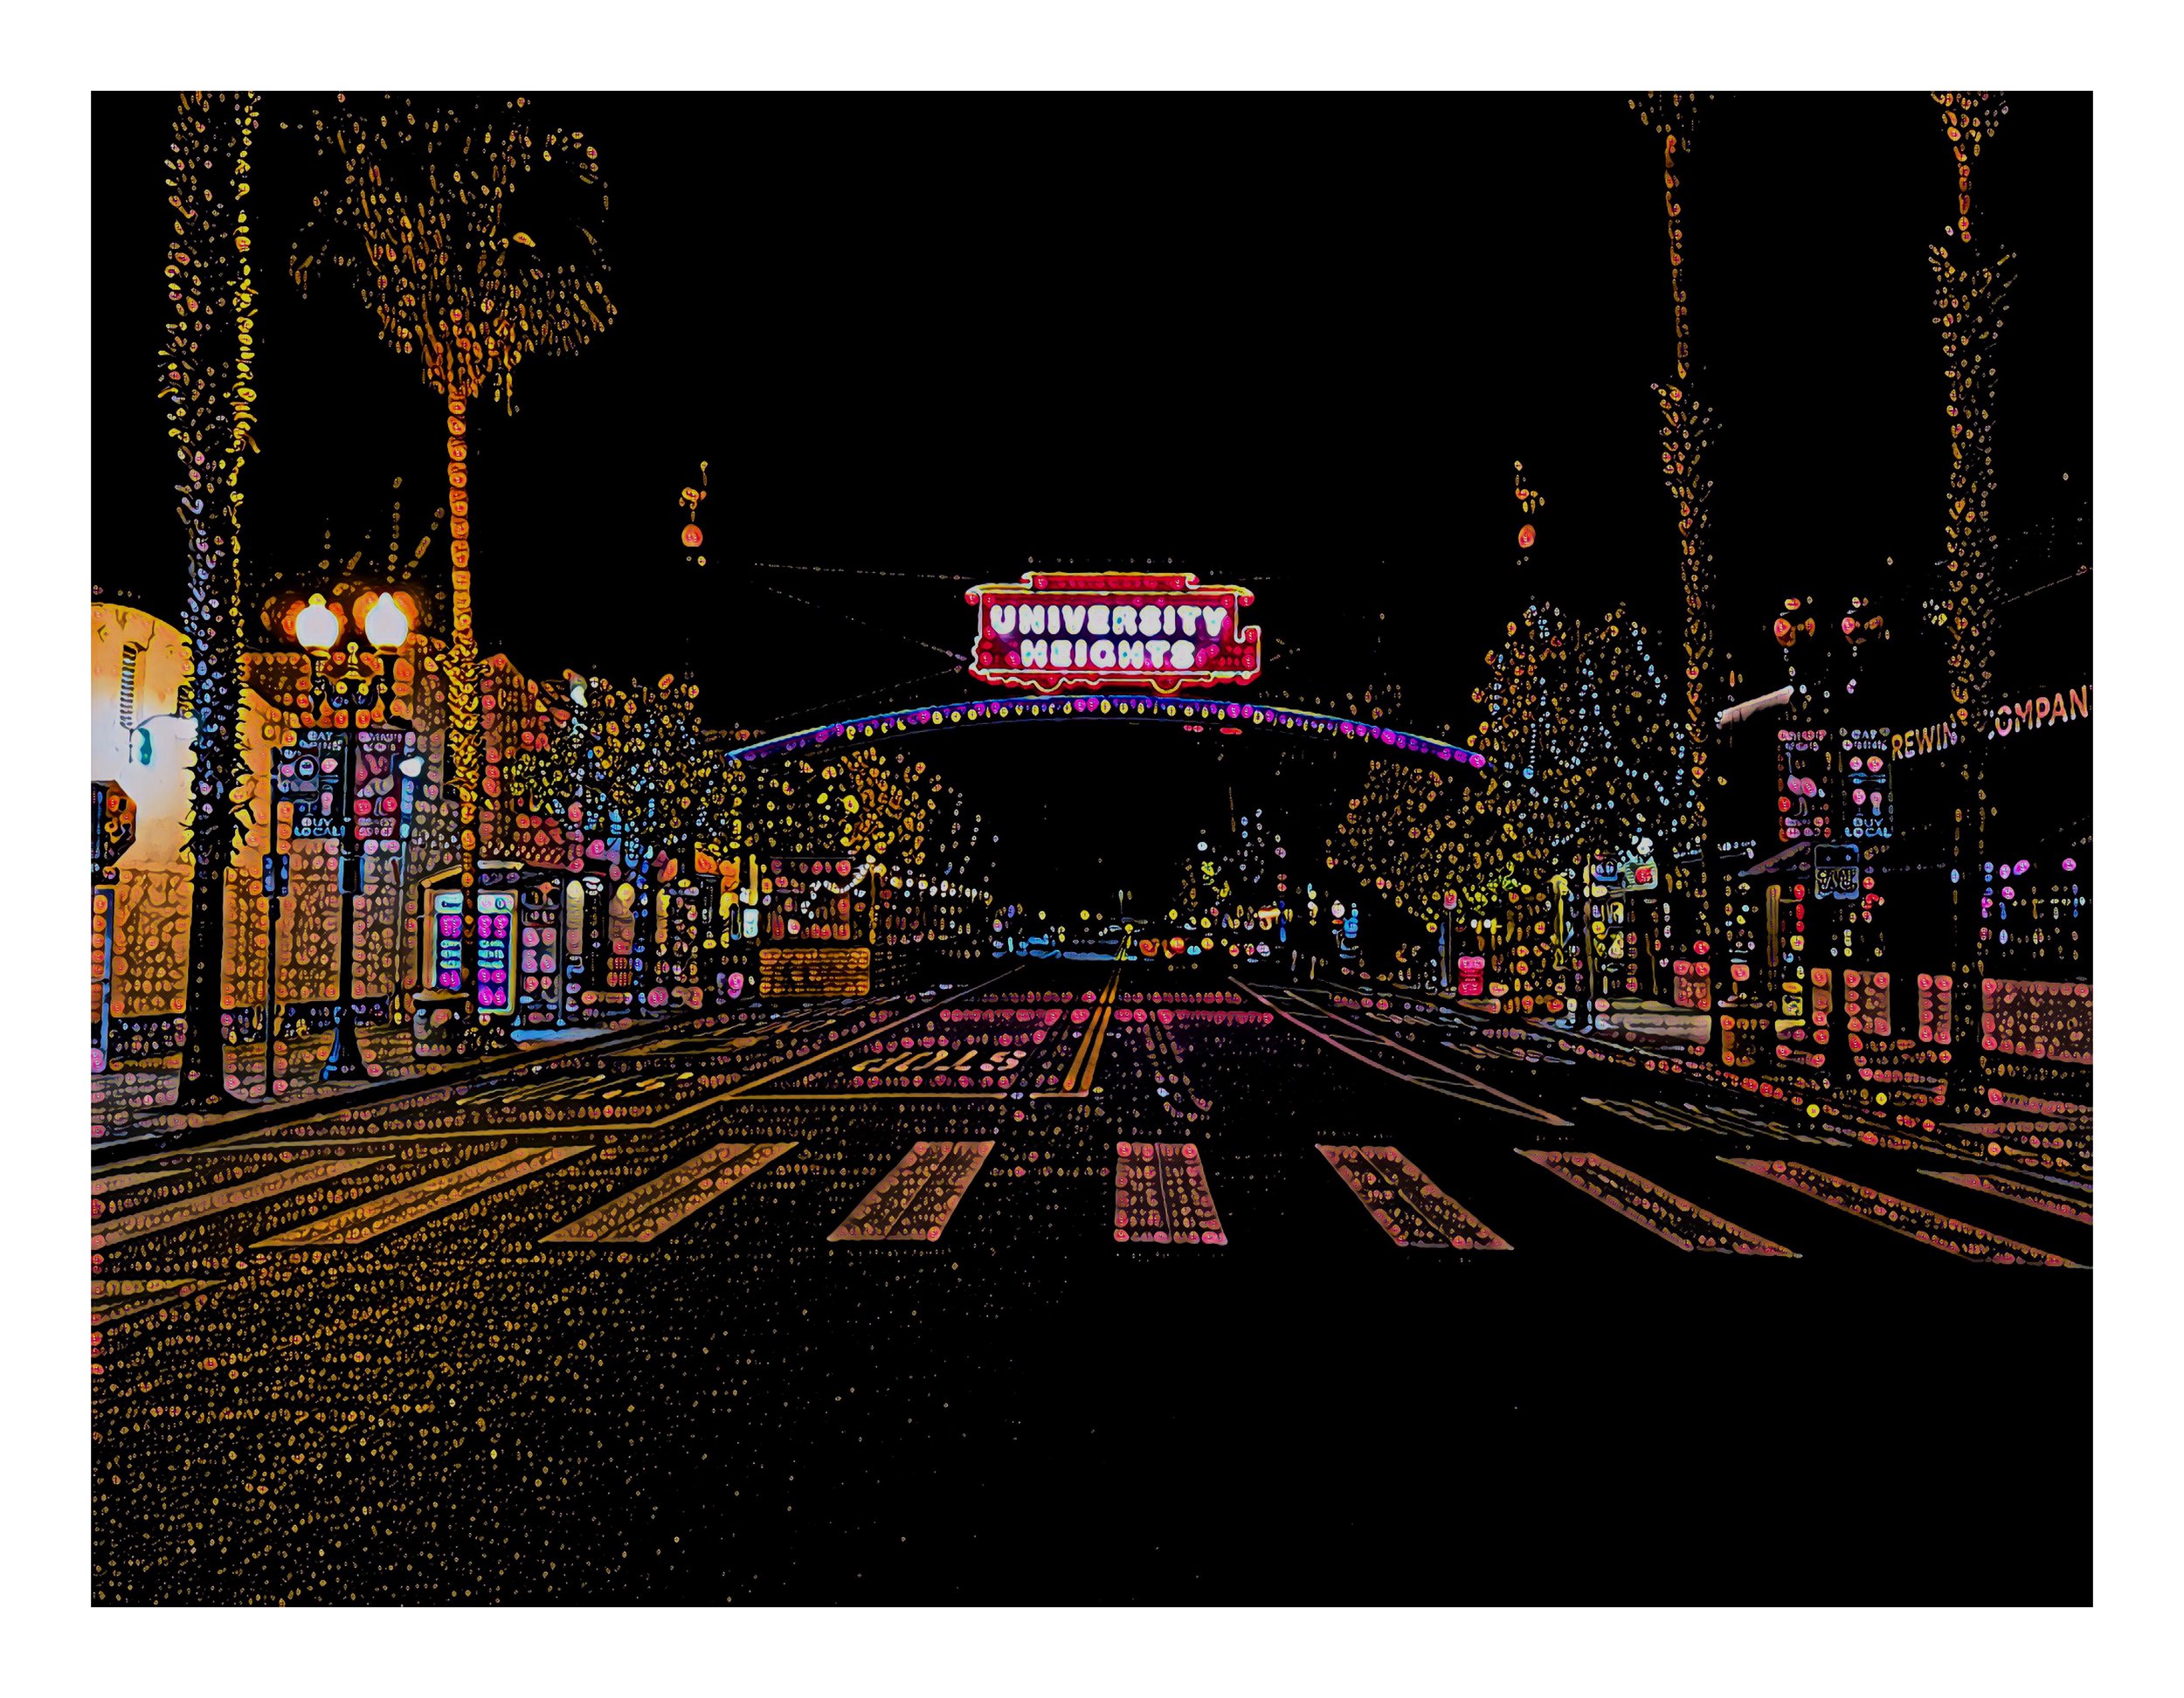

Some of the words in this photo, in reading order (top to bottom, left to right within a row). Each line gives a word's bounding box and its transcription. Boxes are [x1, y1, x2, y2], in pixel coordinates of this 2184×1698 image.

[990, 604, 1227, 637] UNIVERSITY
[1019, 639, 1195, 669] HEIGHTS
[1890, 721, 1959, 762] REWIN
[1988, 684, 2093, 739] OMPAN
